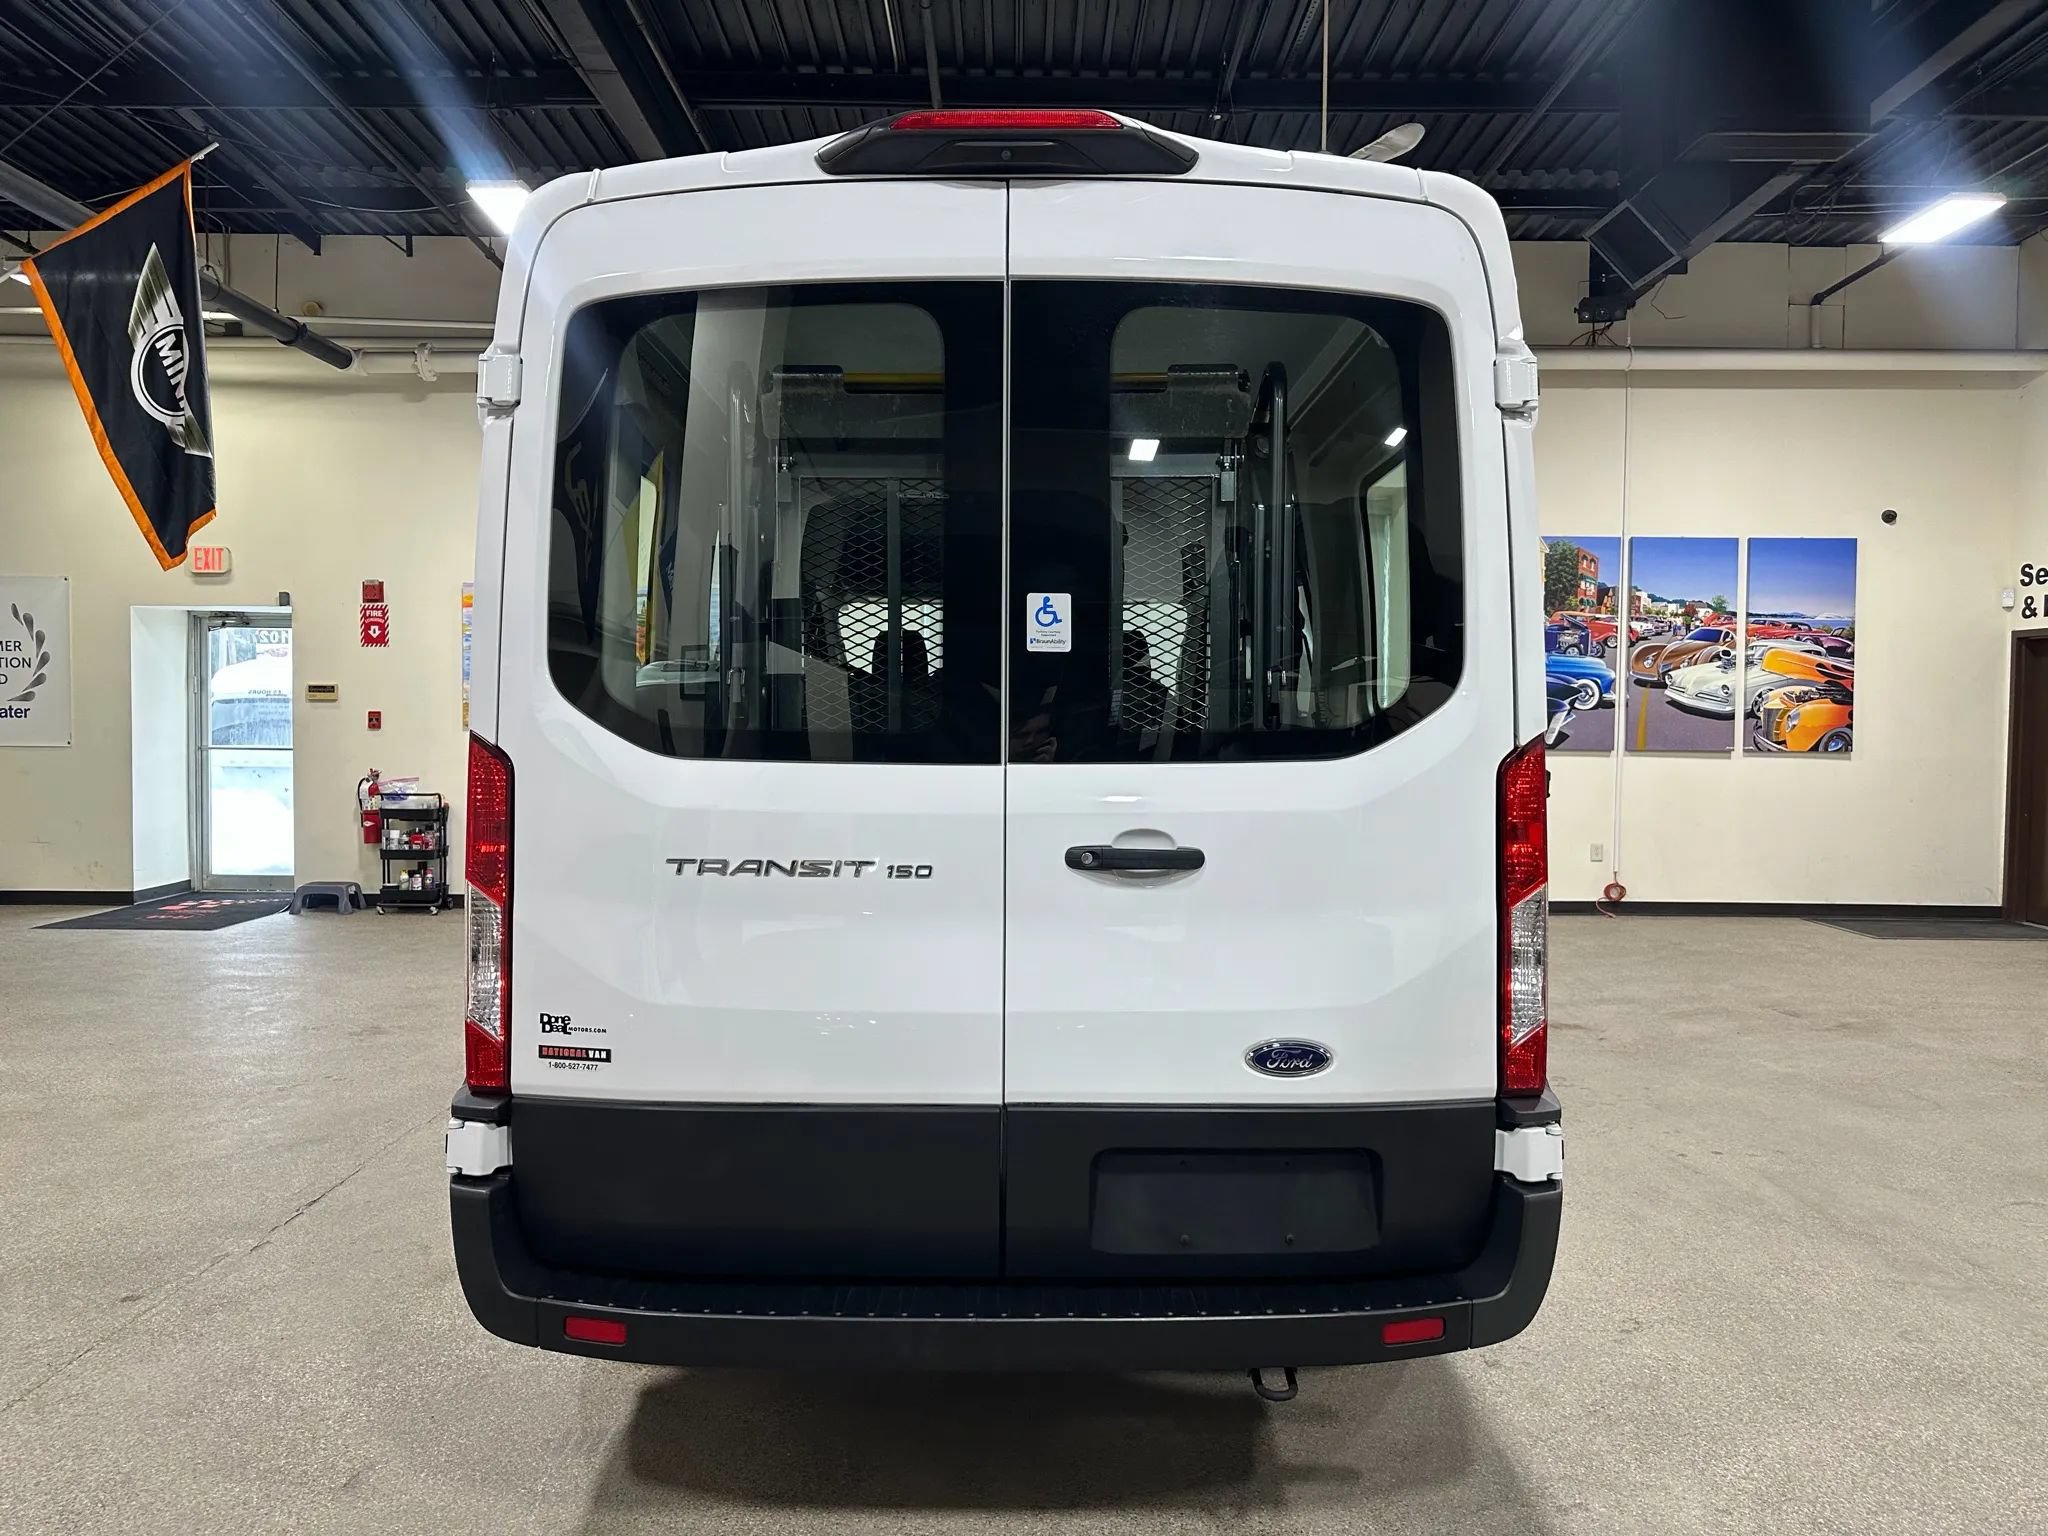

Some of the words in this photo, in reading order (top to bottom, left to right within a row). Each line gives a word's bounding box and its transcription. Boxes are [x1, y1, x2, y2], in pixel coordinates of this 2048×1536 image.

[194, 547, 224, 571] EXIT
[2020, 563, 2048, 587] Se
[366, 609, 383, 617] FIRE
[2021, 595, 2038, 619] &
[665, 858, 876, 878] TRANSIT
[887, 864, 933, 879] 150
[542, 1046, 587, 1058] NATIONAL
[588, 1049, 607, 1059] VAN
[1266, 1048, 1314, 1069] Ford
[548, 1061, 599, 1071] 1-800-527-7477
